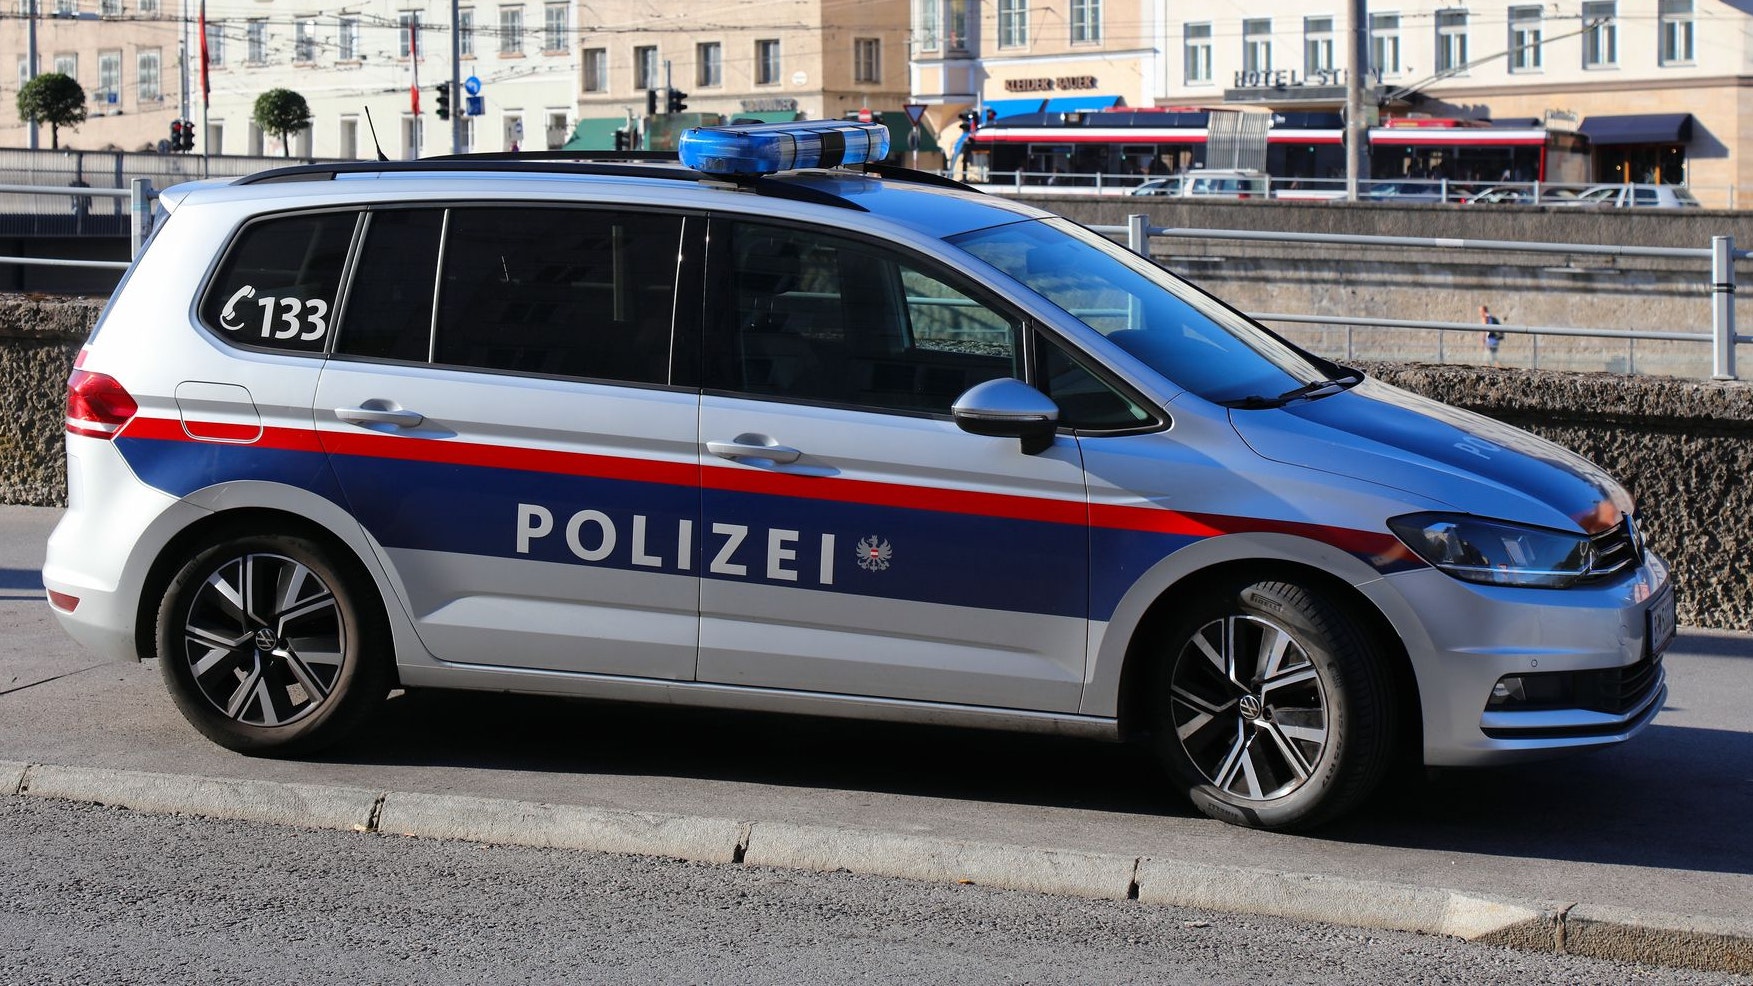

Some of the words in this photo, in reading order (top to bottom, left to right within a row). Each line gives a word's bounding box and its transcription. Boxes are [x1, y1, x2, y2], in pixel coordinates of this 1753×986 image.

[1005, 79, 1053, 92] KLEIDER
[1234, 69, 1303, 88] HOTEL
[1317, 67, 1383, 87] STN
[258, 297, 328, 341] 133
[516, 502, 836, 585] POLIZEI
